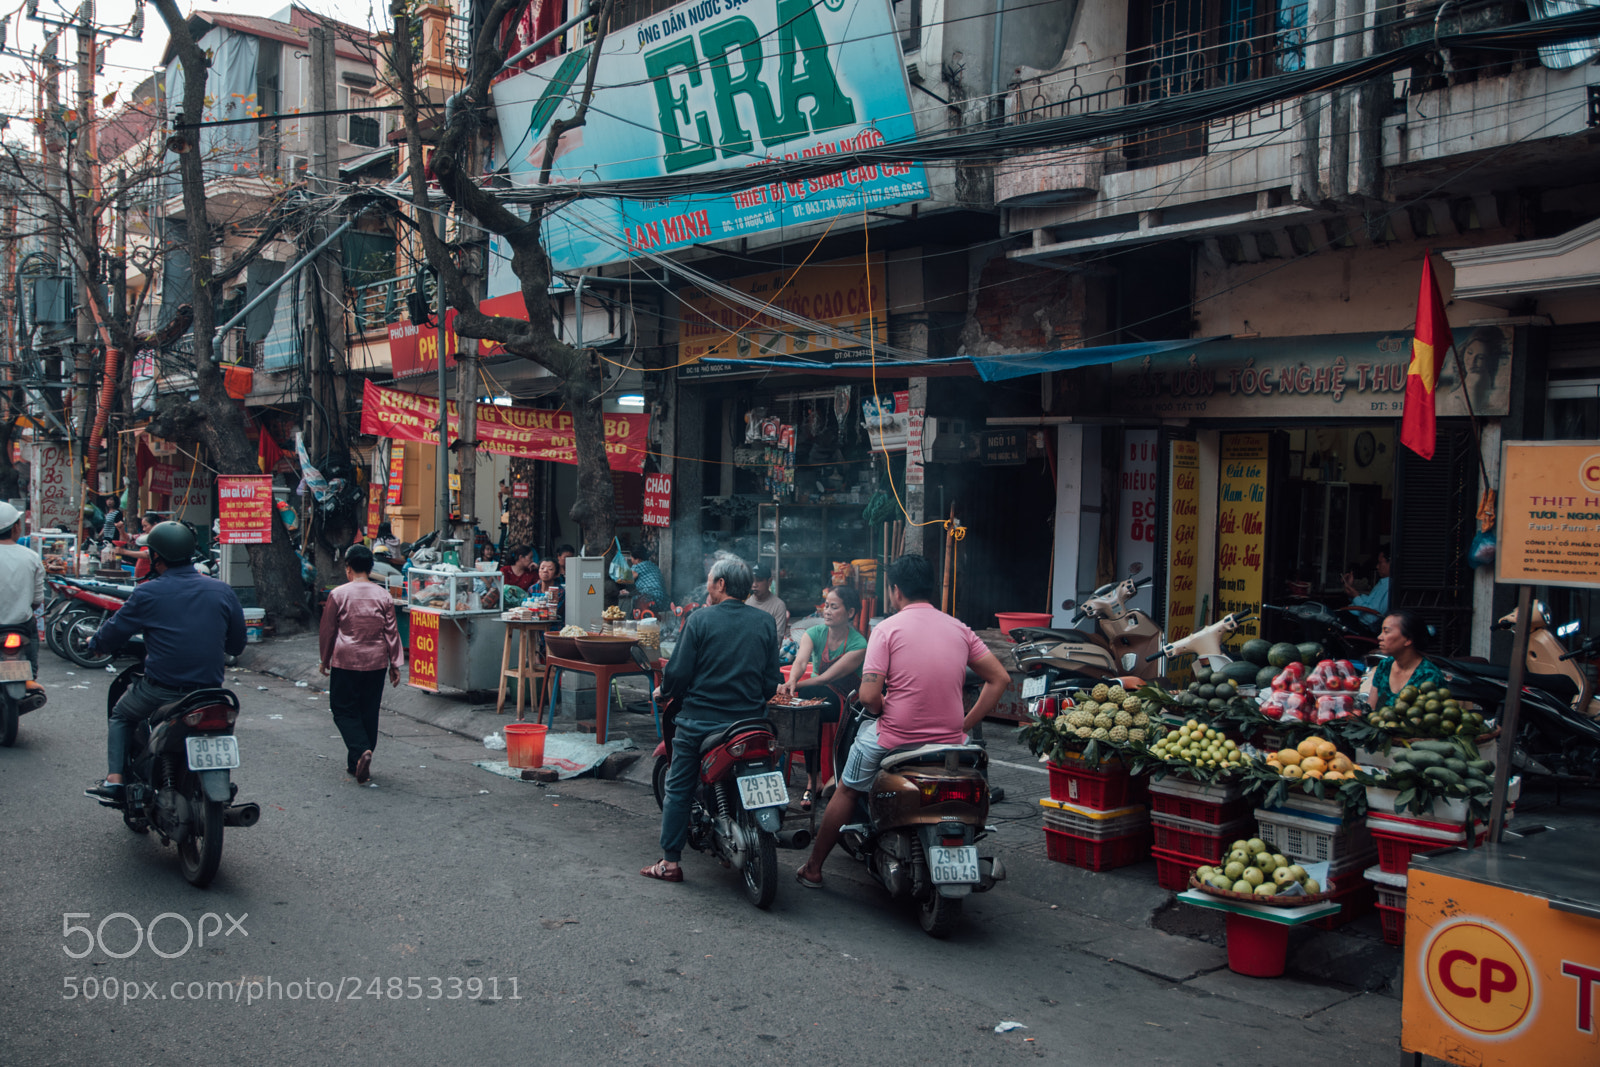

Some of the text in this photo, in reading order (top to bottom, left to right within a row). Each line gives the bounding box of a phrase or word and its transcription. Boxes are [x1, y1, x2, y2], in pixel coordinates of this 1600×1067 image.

[644, 0, 856, 173] ERA
[624, 209, 712, 252] LAN MINH
[813, 291, 844, 321] CAO
[1229, 357, 1273, 395] TÓC
[1279, 351, 1348, 401] NGHỆ
[519, 445, 528, 455] 3
[645, 474, 671, 494] CHÁO
[658, 499, 670, 509] TIM
[1529, 496, 1577, 509] THỊT
[411, 611, 439, 630] THANH
[416, 633, 434, 652] GIÒ
[414, 656, 435, 678] CHẢ
[196, 753, 232, 767] 6963
[745, 775, 778, 792] 29-X5
[746, 789, 782, 806] 4015
[937, 849, 971, 865] 29-B1
[934, 865, 977, 881] 060.46
[1438, 950, 1517, 1003] CP
